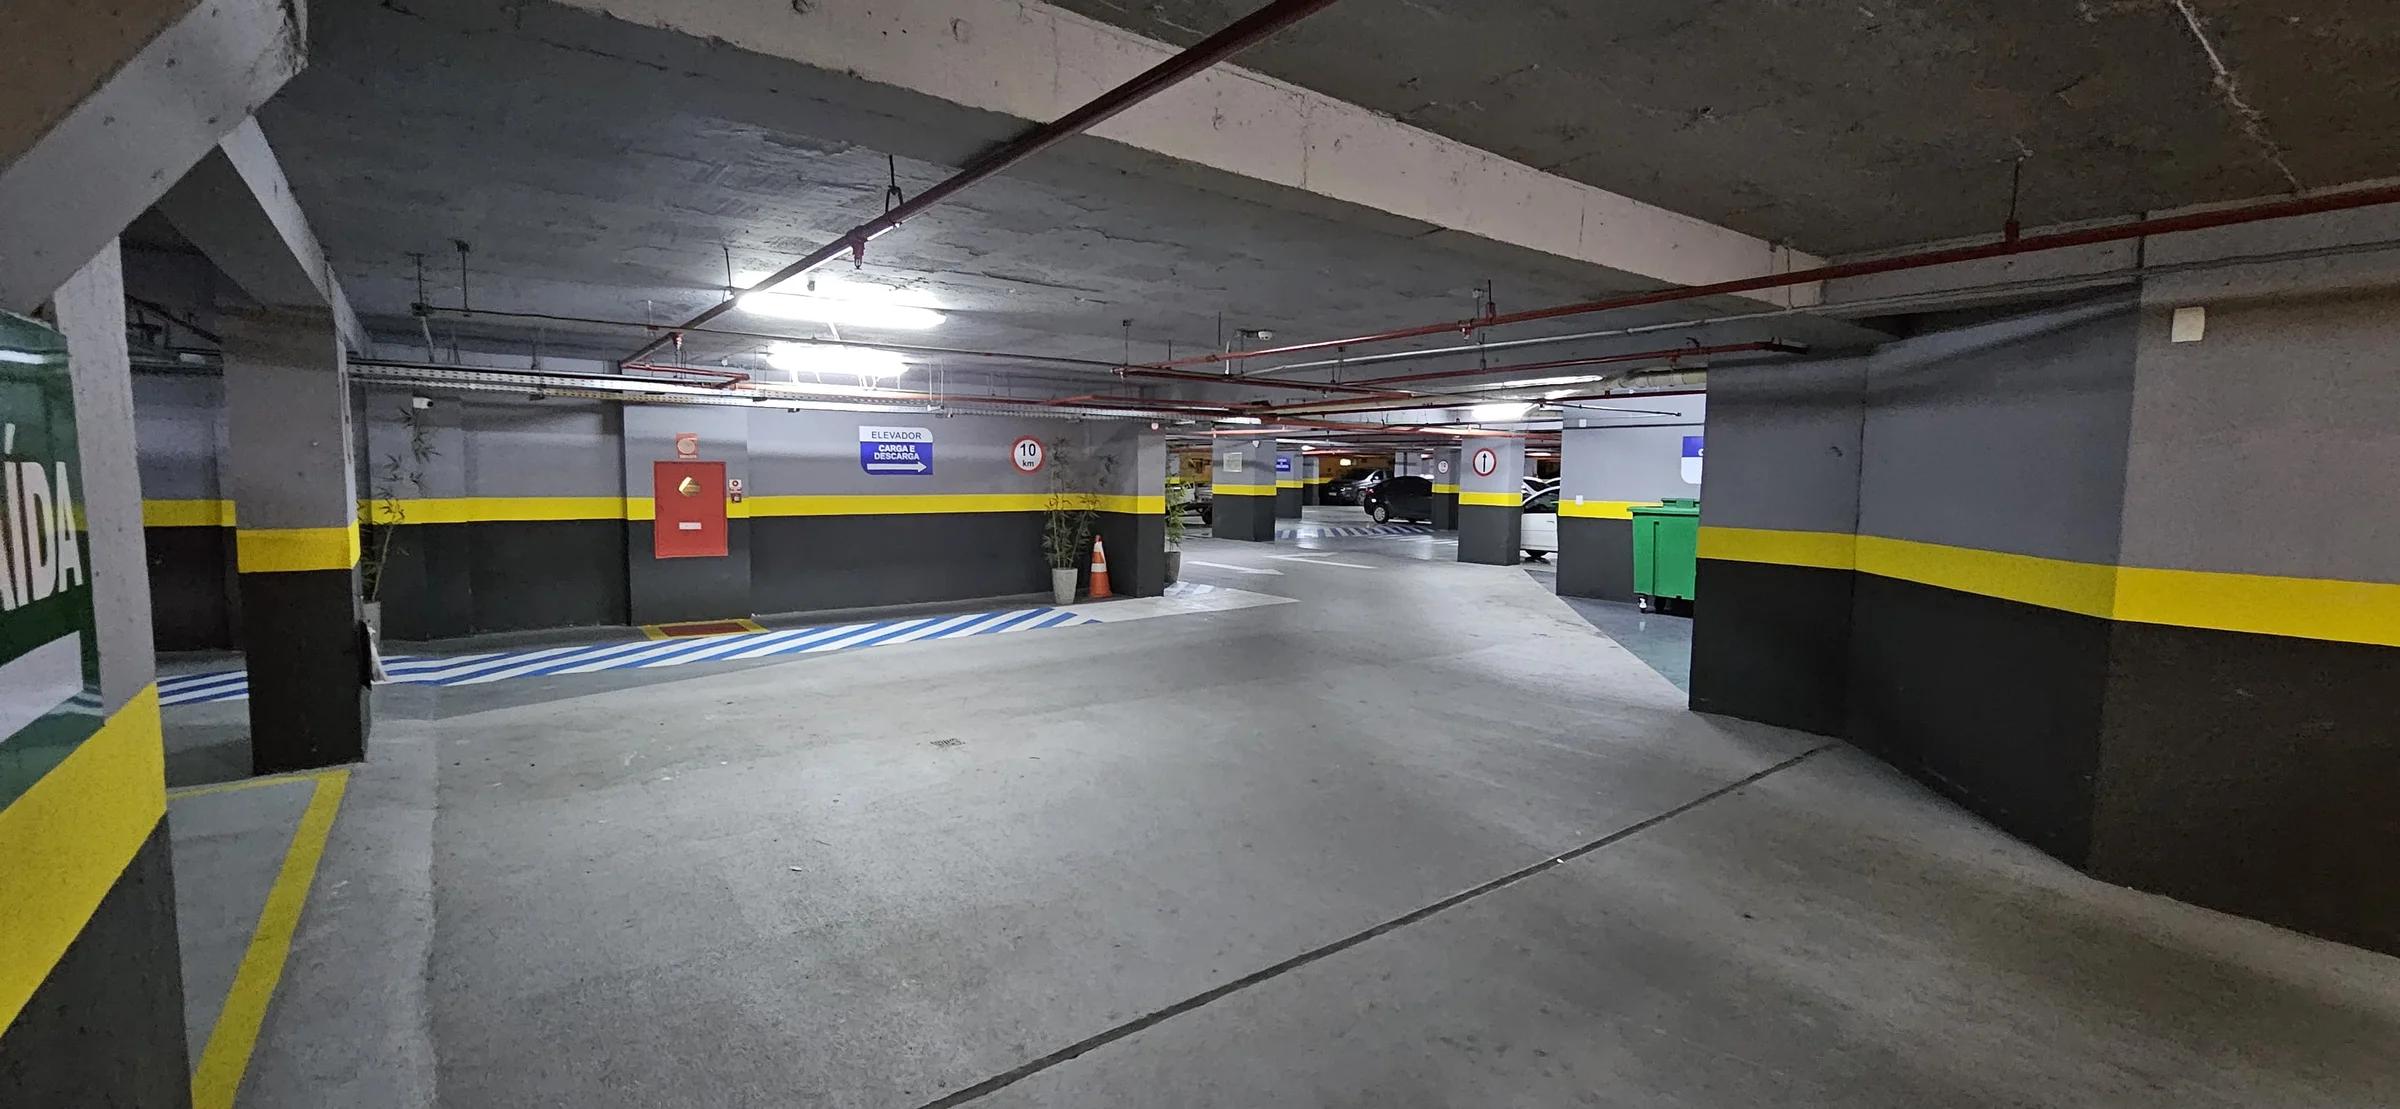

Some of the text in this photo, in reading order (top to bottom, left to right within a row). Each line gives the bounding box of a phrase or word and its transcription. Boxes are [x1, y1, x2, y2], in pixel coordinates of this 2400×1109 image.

[871, 431, 922, 440] ELEVADOR
[878, 444, 916, 453] CARGA E
[1020, 443, 1036, 457] 10
[873, 452, 920, 460] DESCARGA
[1022, 459, 1035, 467] km
